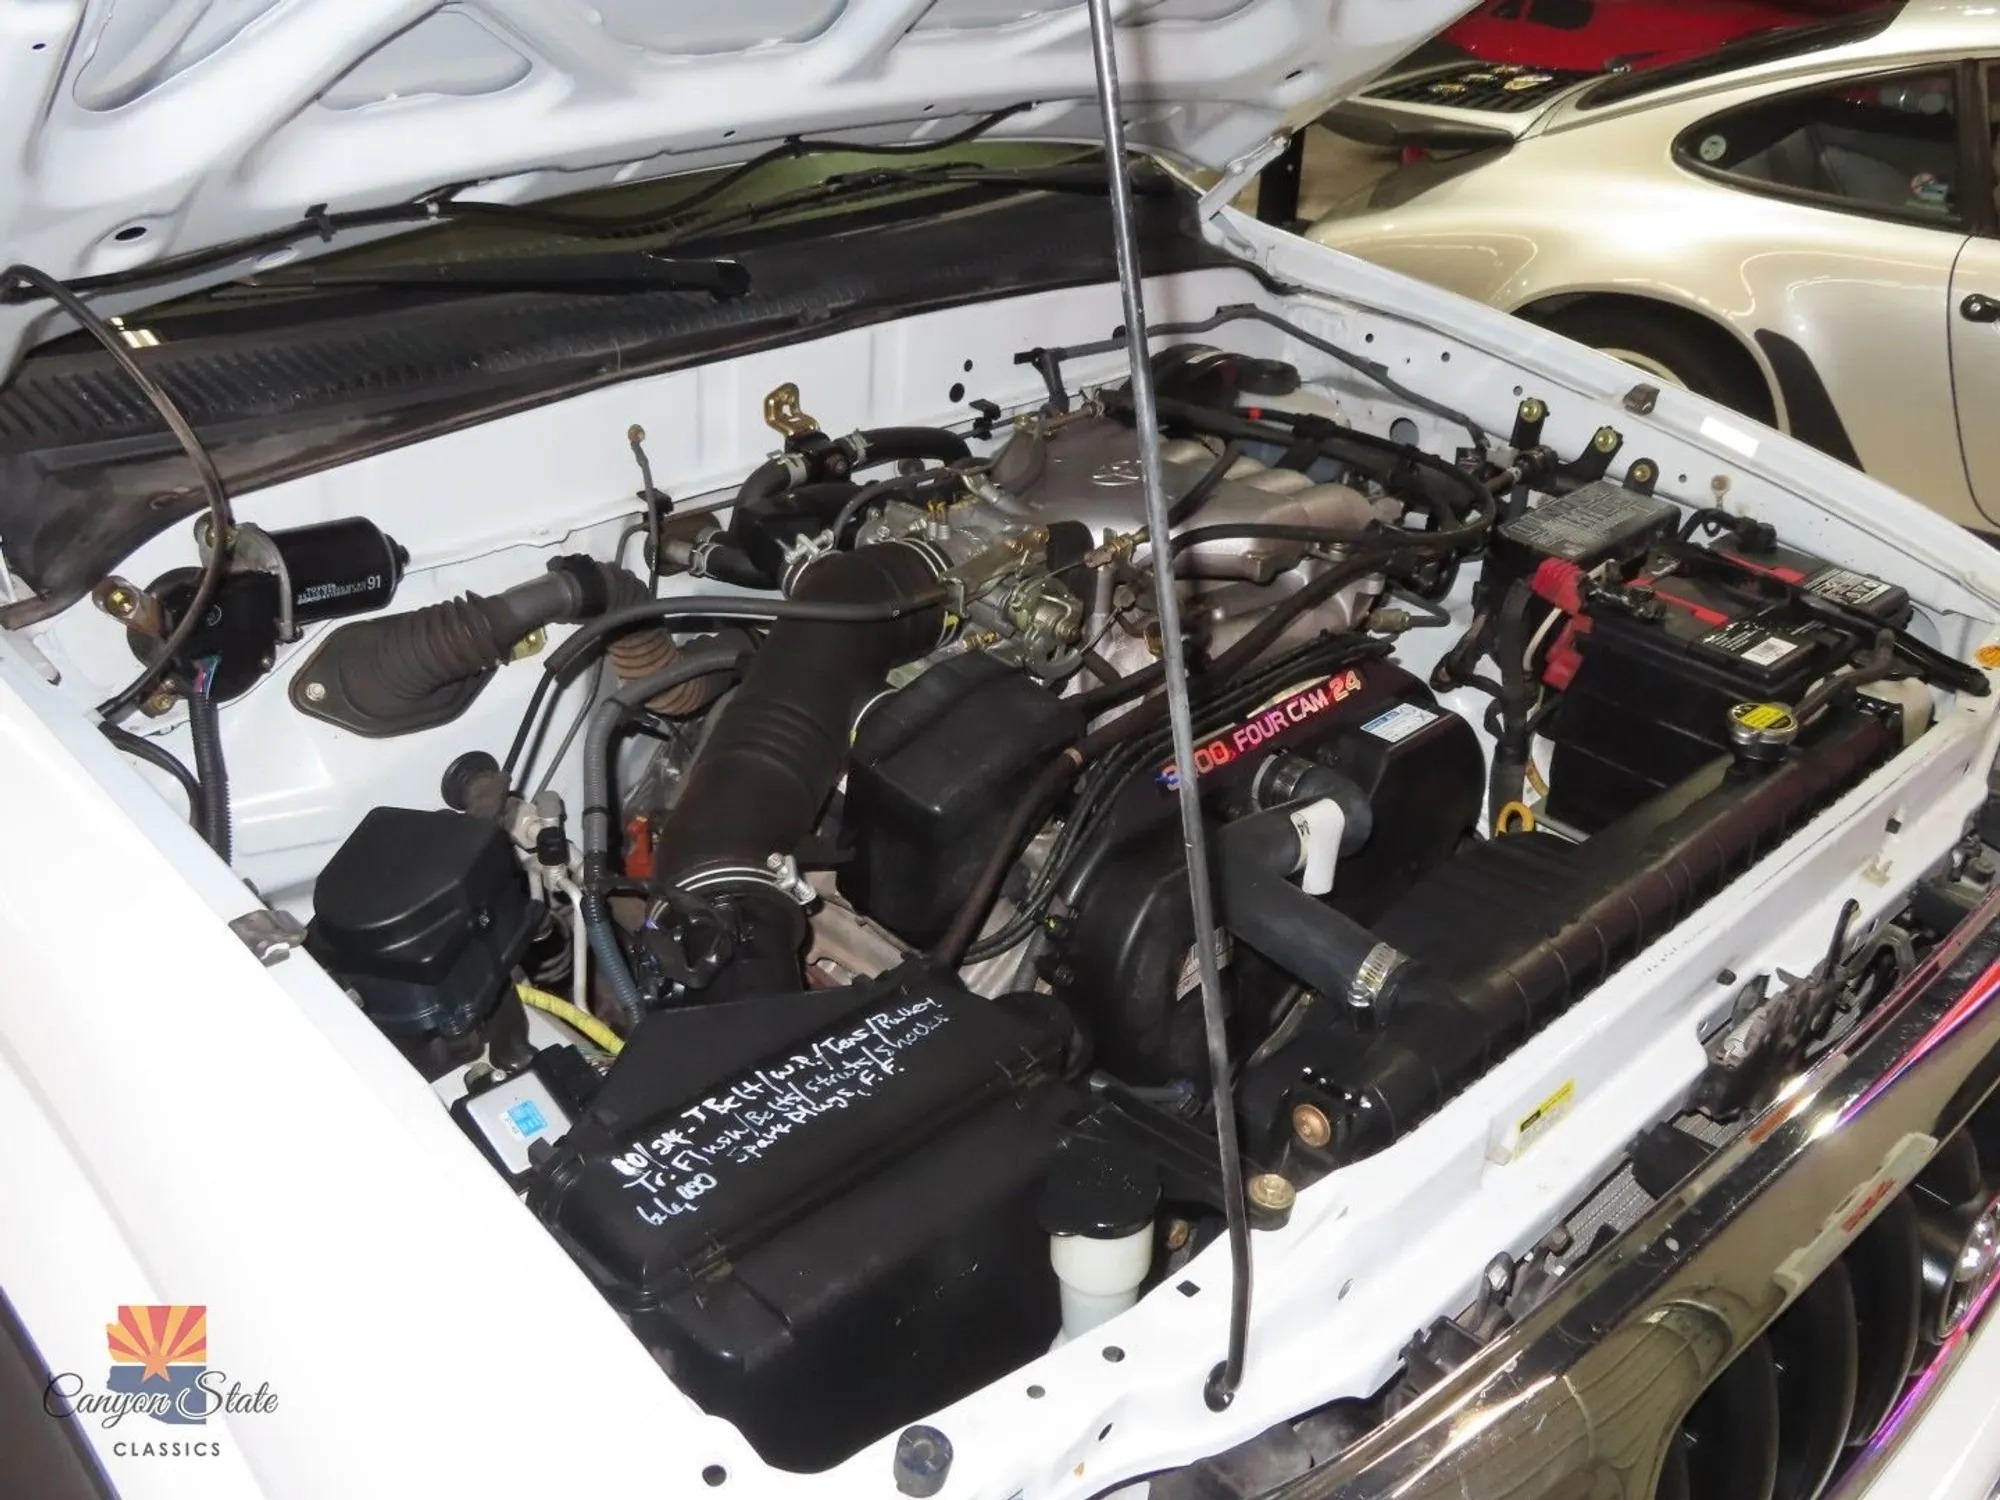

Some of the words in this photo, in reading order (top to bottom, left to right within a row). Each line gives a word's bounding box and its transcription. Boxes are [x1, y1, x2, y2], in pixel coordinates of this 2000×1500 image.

[367, 575, 381, 590] 91
[1162, 741, 1229, 791] 300
[1233, 711, 1289, 752] FOUR
[1286, 689, 1329, 722] CAM
[1329, 670, 1361, 701] 24
